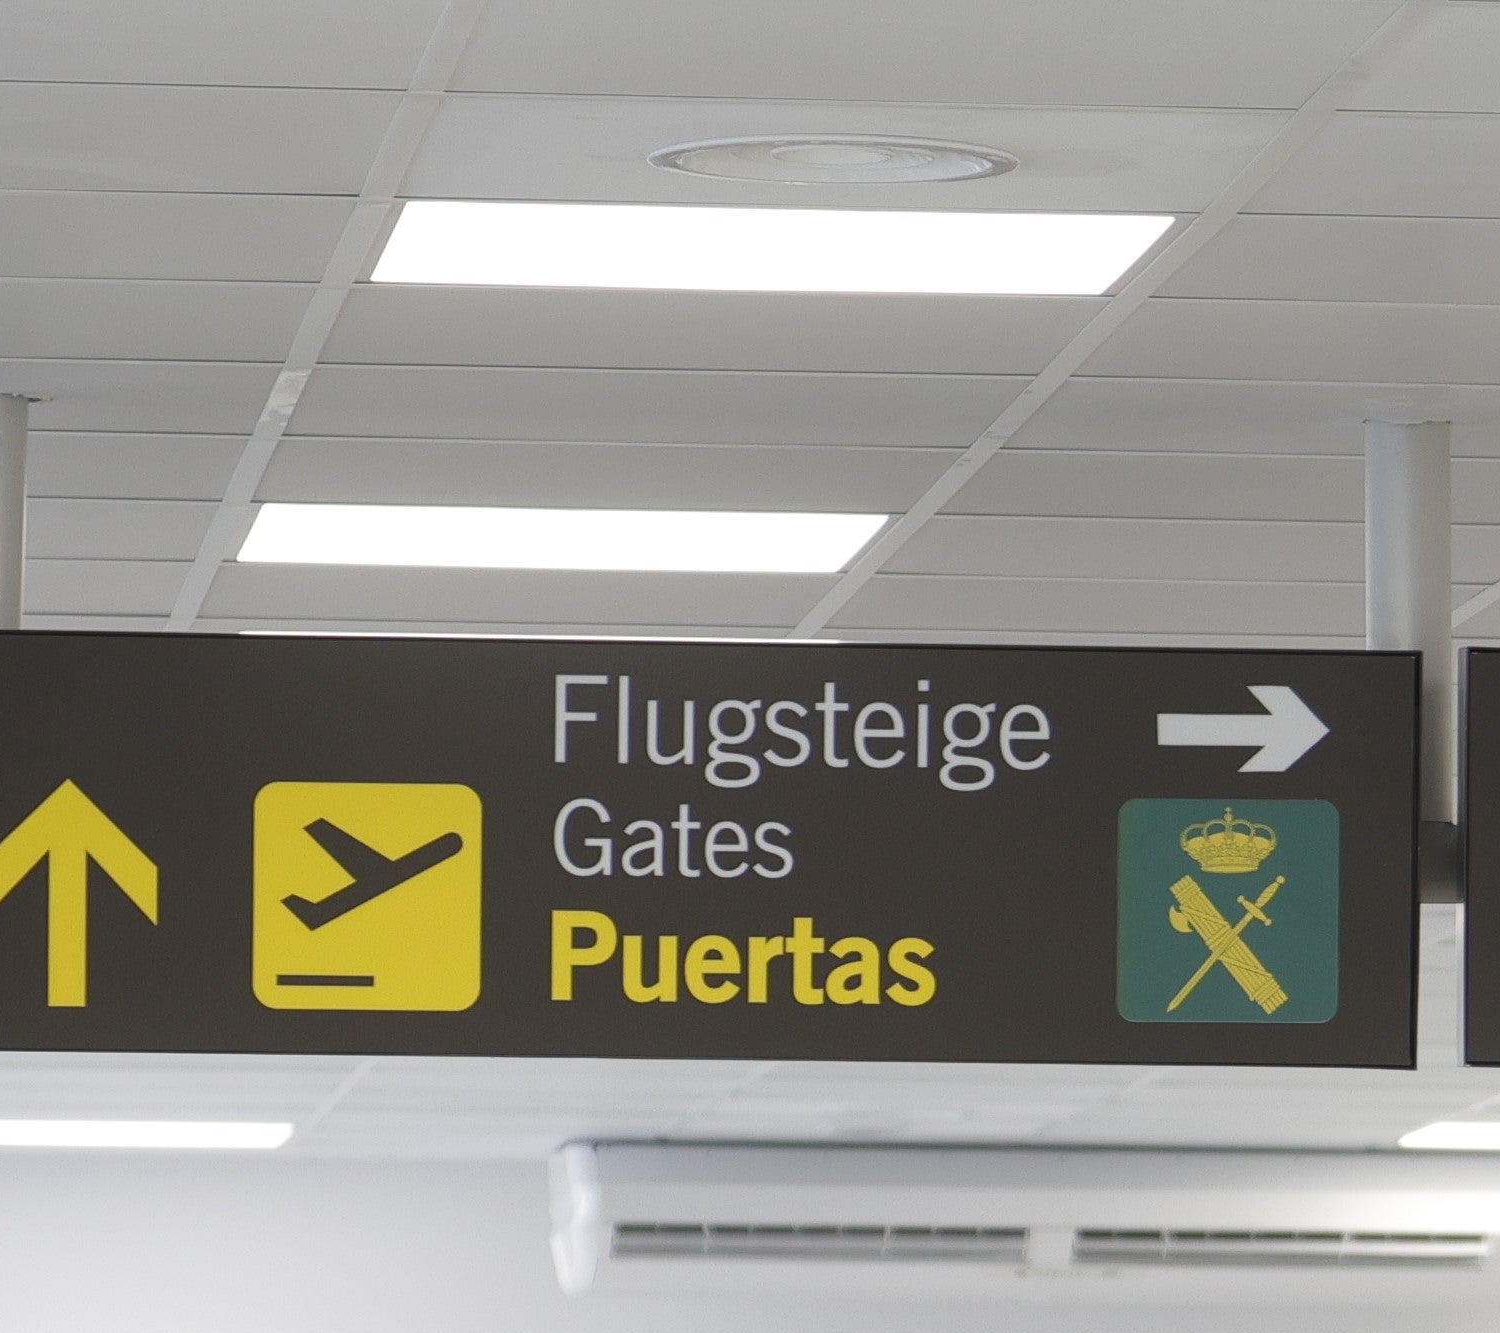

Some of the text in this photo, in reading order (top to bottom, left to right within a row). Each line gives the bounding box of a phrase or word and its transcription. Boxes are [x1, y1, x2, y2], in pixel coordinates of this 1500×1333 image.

[553, 673, 1052, 792] Flugsteige
[552, 797, 796, 880] Gates
[550, 908, 938, 1008] Puertas
